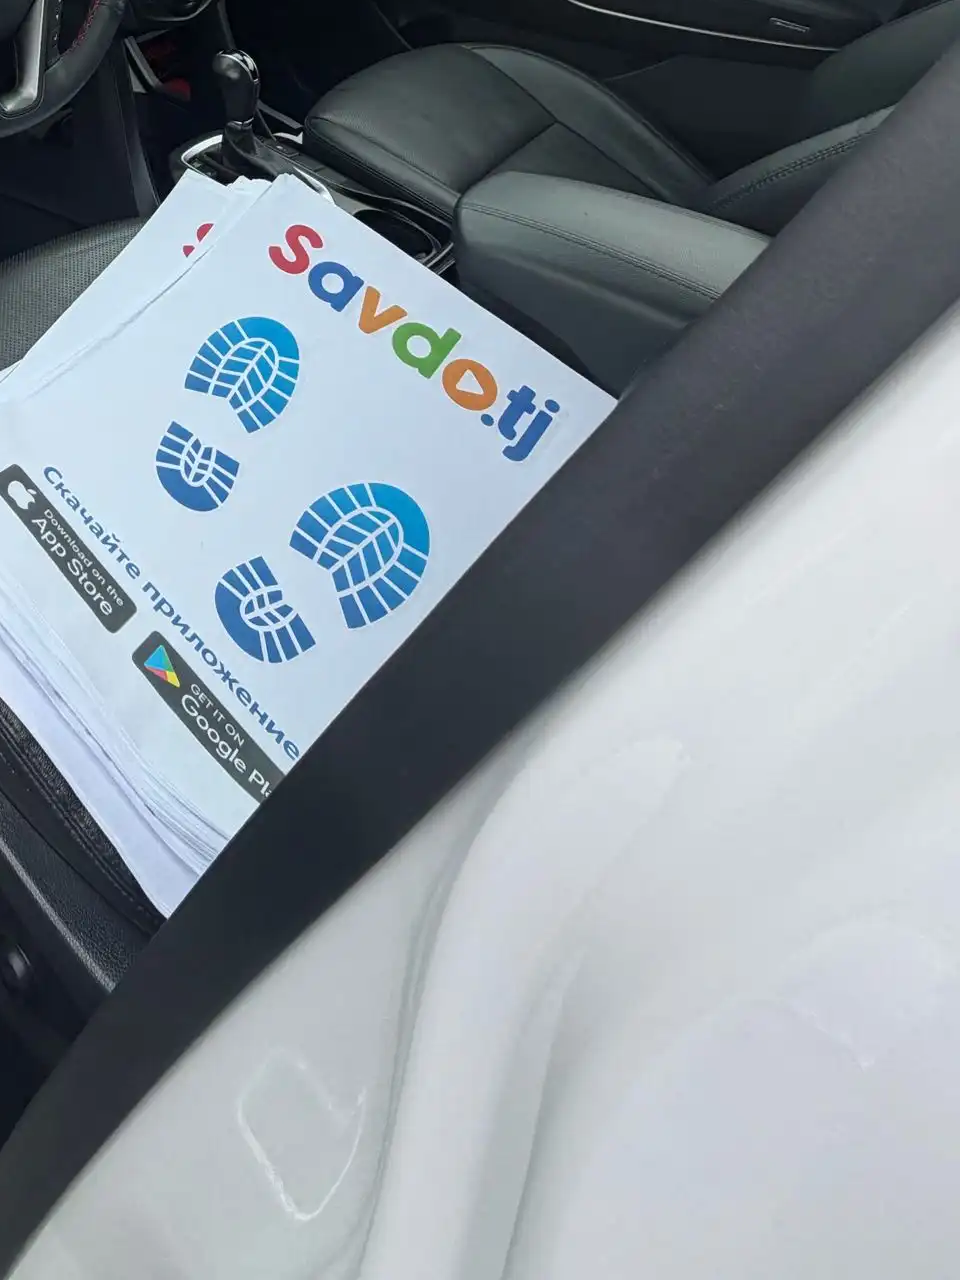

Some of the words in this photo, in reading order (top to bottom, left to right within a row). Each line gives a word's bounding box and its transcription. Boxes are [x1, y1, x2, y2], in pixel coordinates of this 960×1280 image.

[268, 224, 560, 461] Savdo.tj
[31, 517, 67, 558] App
[67, 558, 113, 615] Store
[44, 509, 93, 567] Download
[91, 568, 106, 585] on
[106, 584, 124, 607] the
[43, 466, 141, 579] Скачайте
[142, 581, 300, 761] приложение
[181, 694, 247, 773] Google
[190, 683, 214, 709] GET
[212, 709, 225, 722] IT
[224, 723, 245, 747] ON
